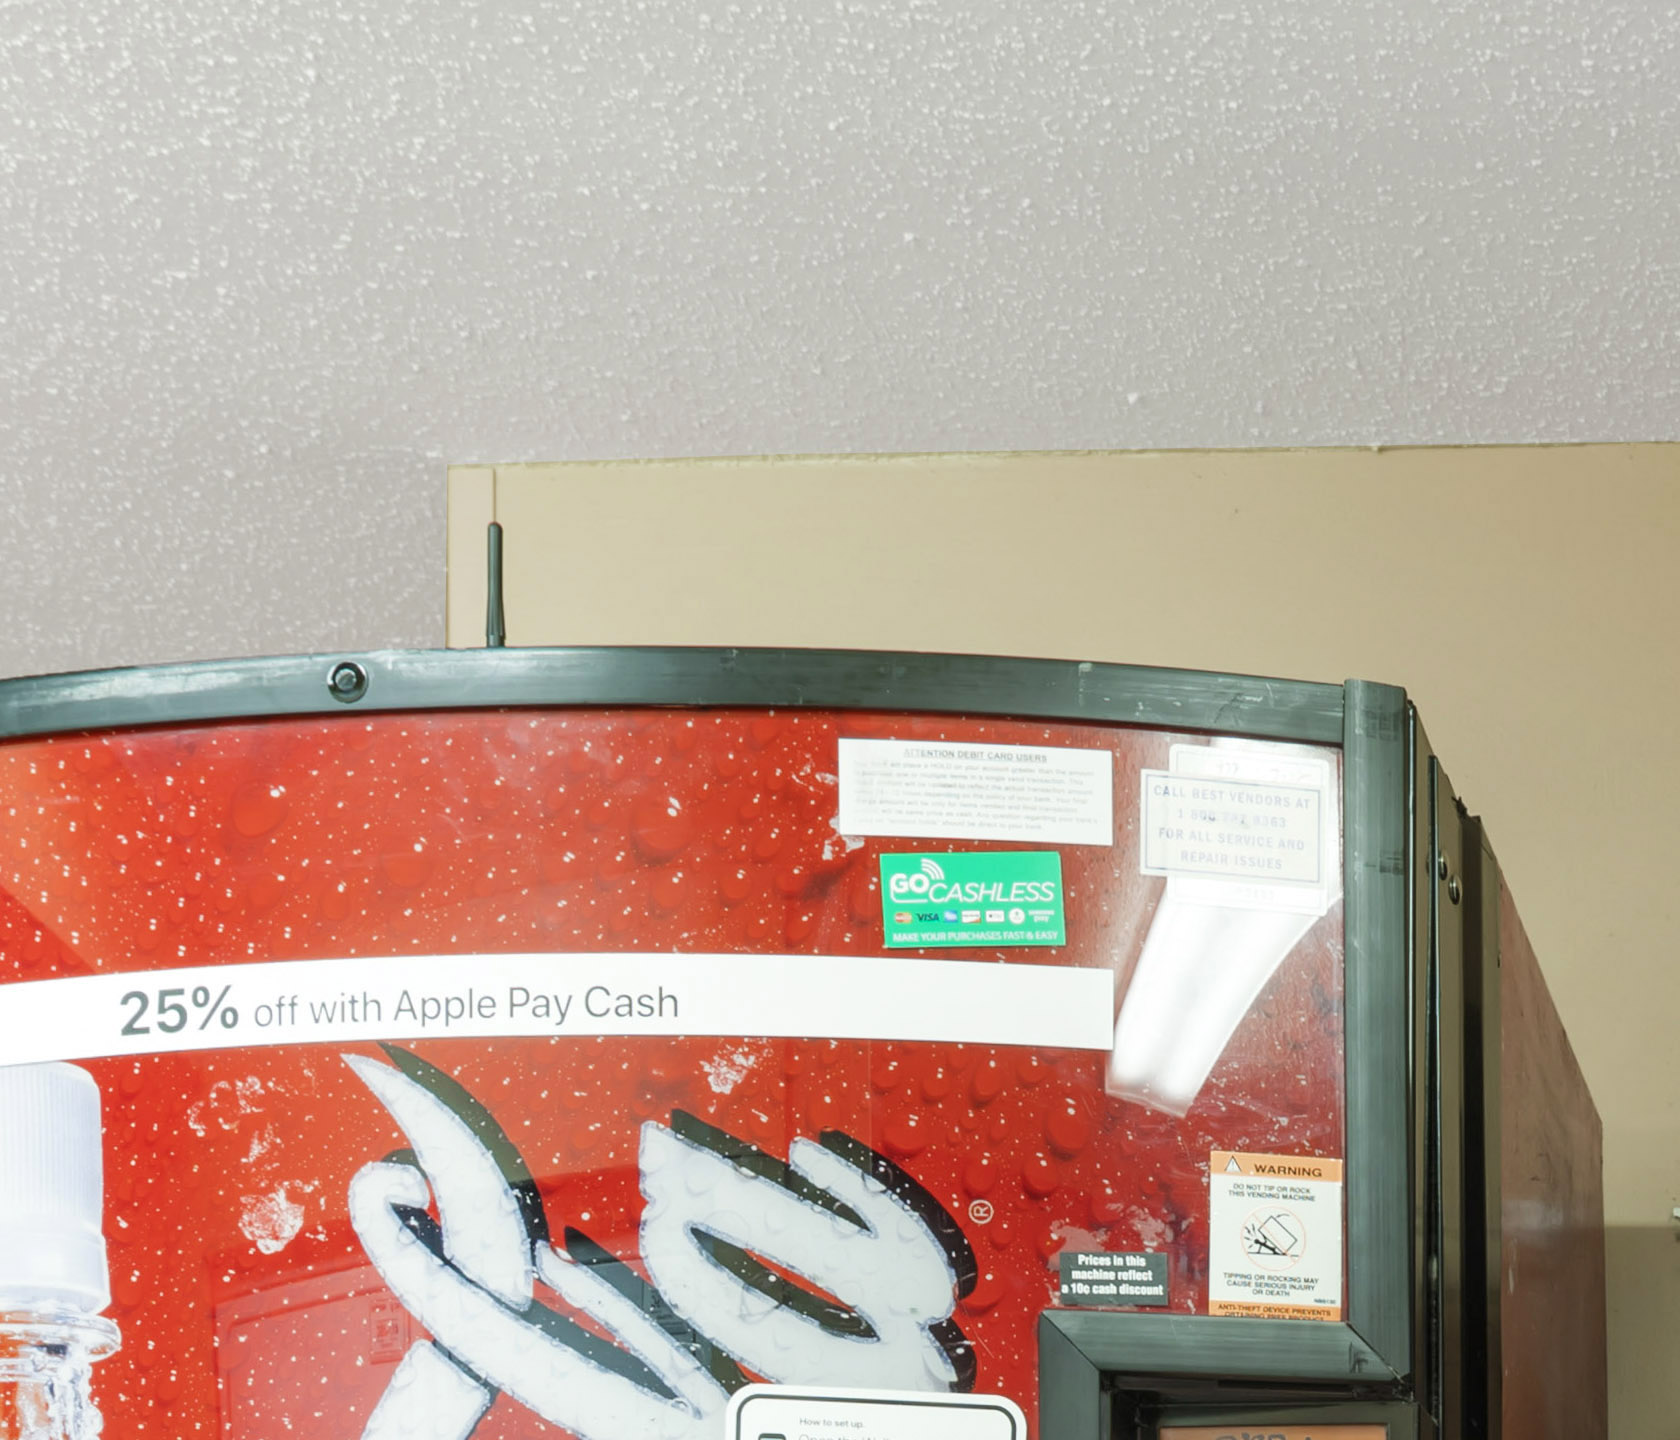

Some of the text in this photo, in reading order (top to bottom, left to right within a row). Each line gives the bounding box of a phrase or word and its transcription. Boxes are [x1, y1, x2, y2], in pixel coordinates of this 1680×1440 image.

[890, 873, 1055, 902] GO CASHLESS
[120, 985, 678, 1036] 25% off with Apple Pay Cash
[1254, 1163, 1322, 1178] WARNING
[1078, 1254, 1146, 1266] Prices in this
[1072, 1270, 1152, 1281] machine reflect
[1062, 1286, 1068, 1294] a
[1092, 1284, 1116, 1295] cash
[1119, 1284, 1163, 1296] discount
